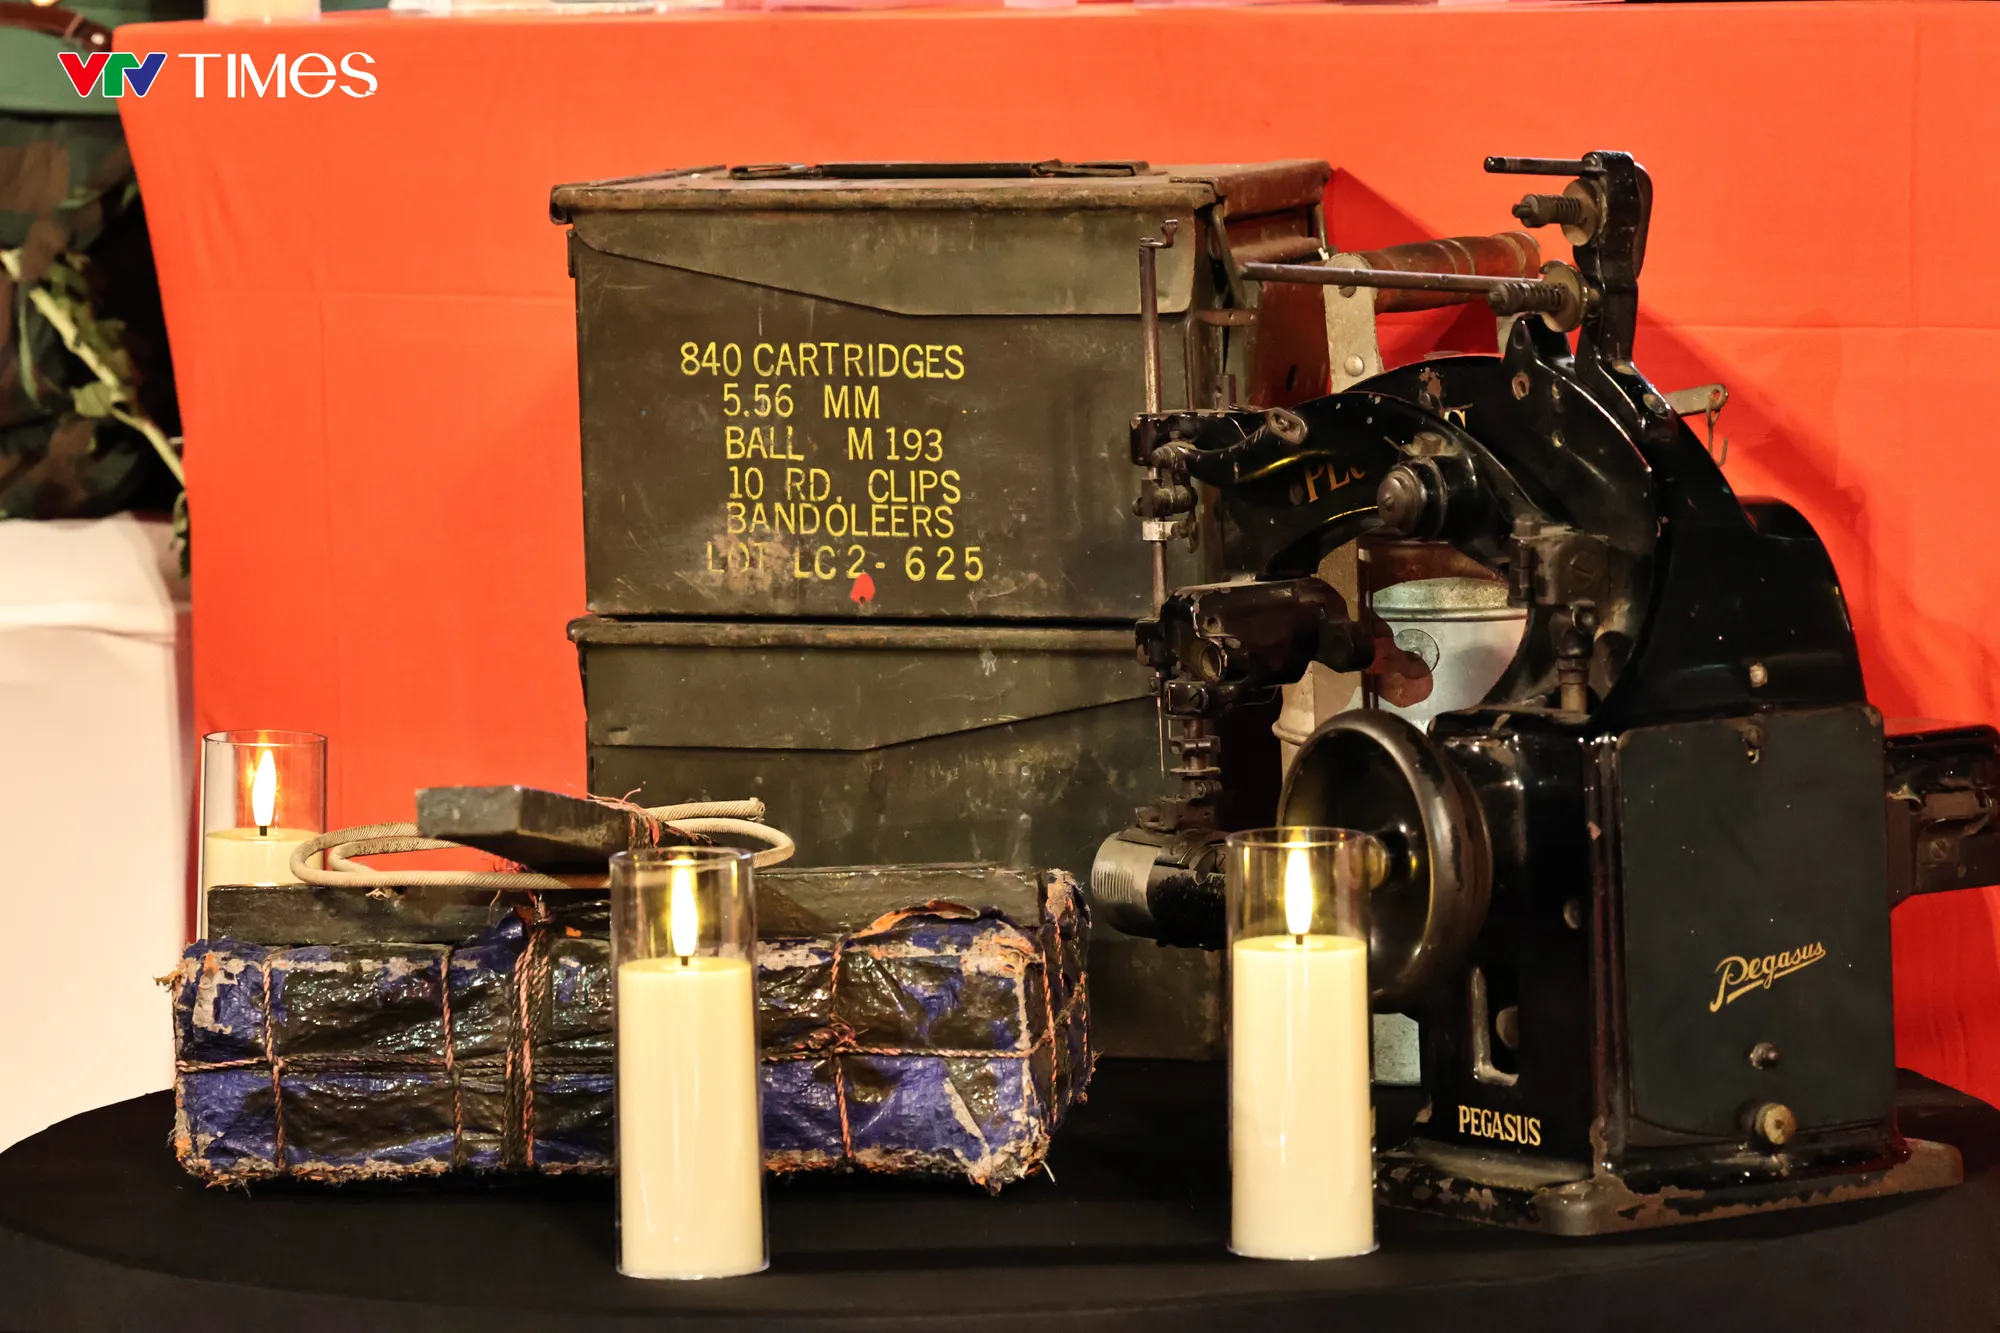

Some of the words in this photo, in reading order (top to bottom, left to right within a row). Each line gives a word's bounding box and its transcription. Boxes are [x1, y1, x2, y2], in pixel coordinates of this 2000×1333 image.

[680, 341, 742, 377] 840
[752, 341, 965, 380] CARTRIDGES
[723, 382, 794, 418] 5.56
[823, 384, 880, 419] MM
[725, 425, 805, 462] BALL
[728, 465, 764, 501] 10
[786, 467, 843, 503] RD.
[867, 468, 961, 505] CLIPS
[725, 502, 955, 537] BANDOLEERS
[1709, 941, 1827, 1013] Pegasus
[1457, 1104, 1542, 1147] PEGASUS
